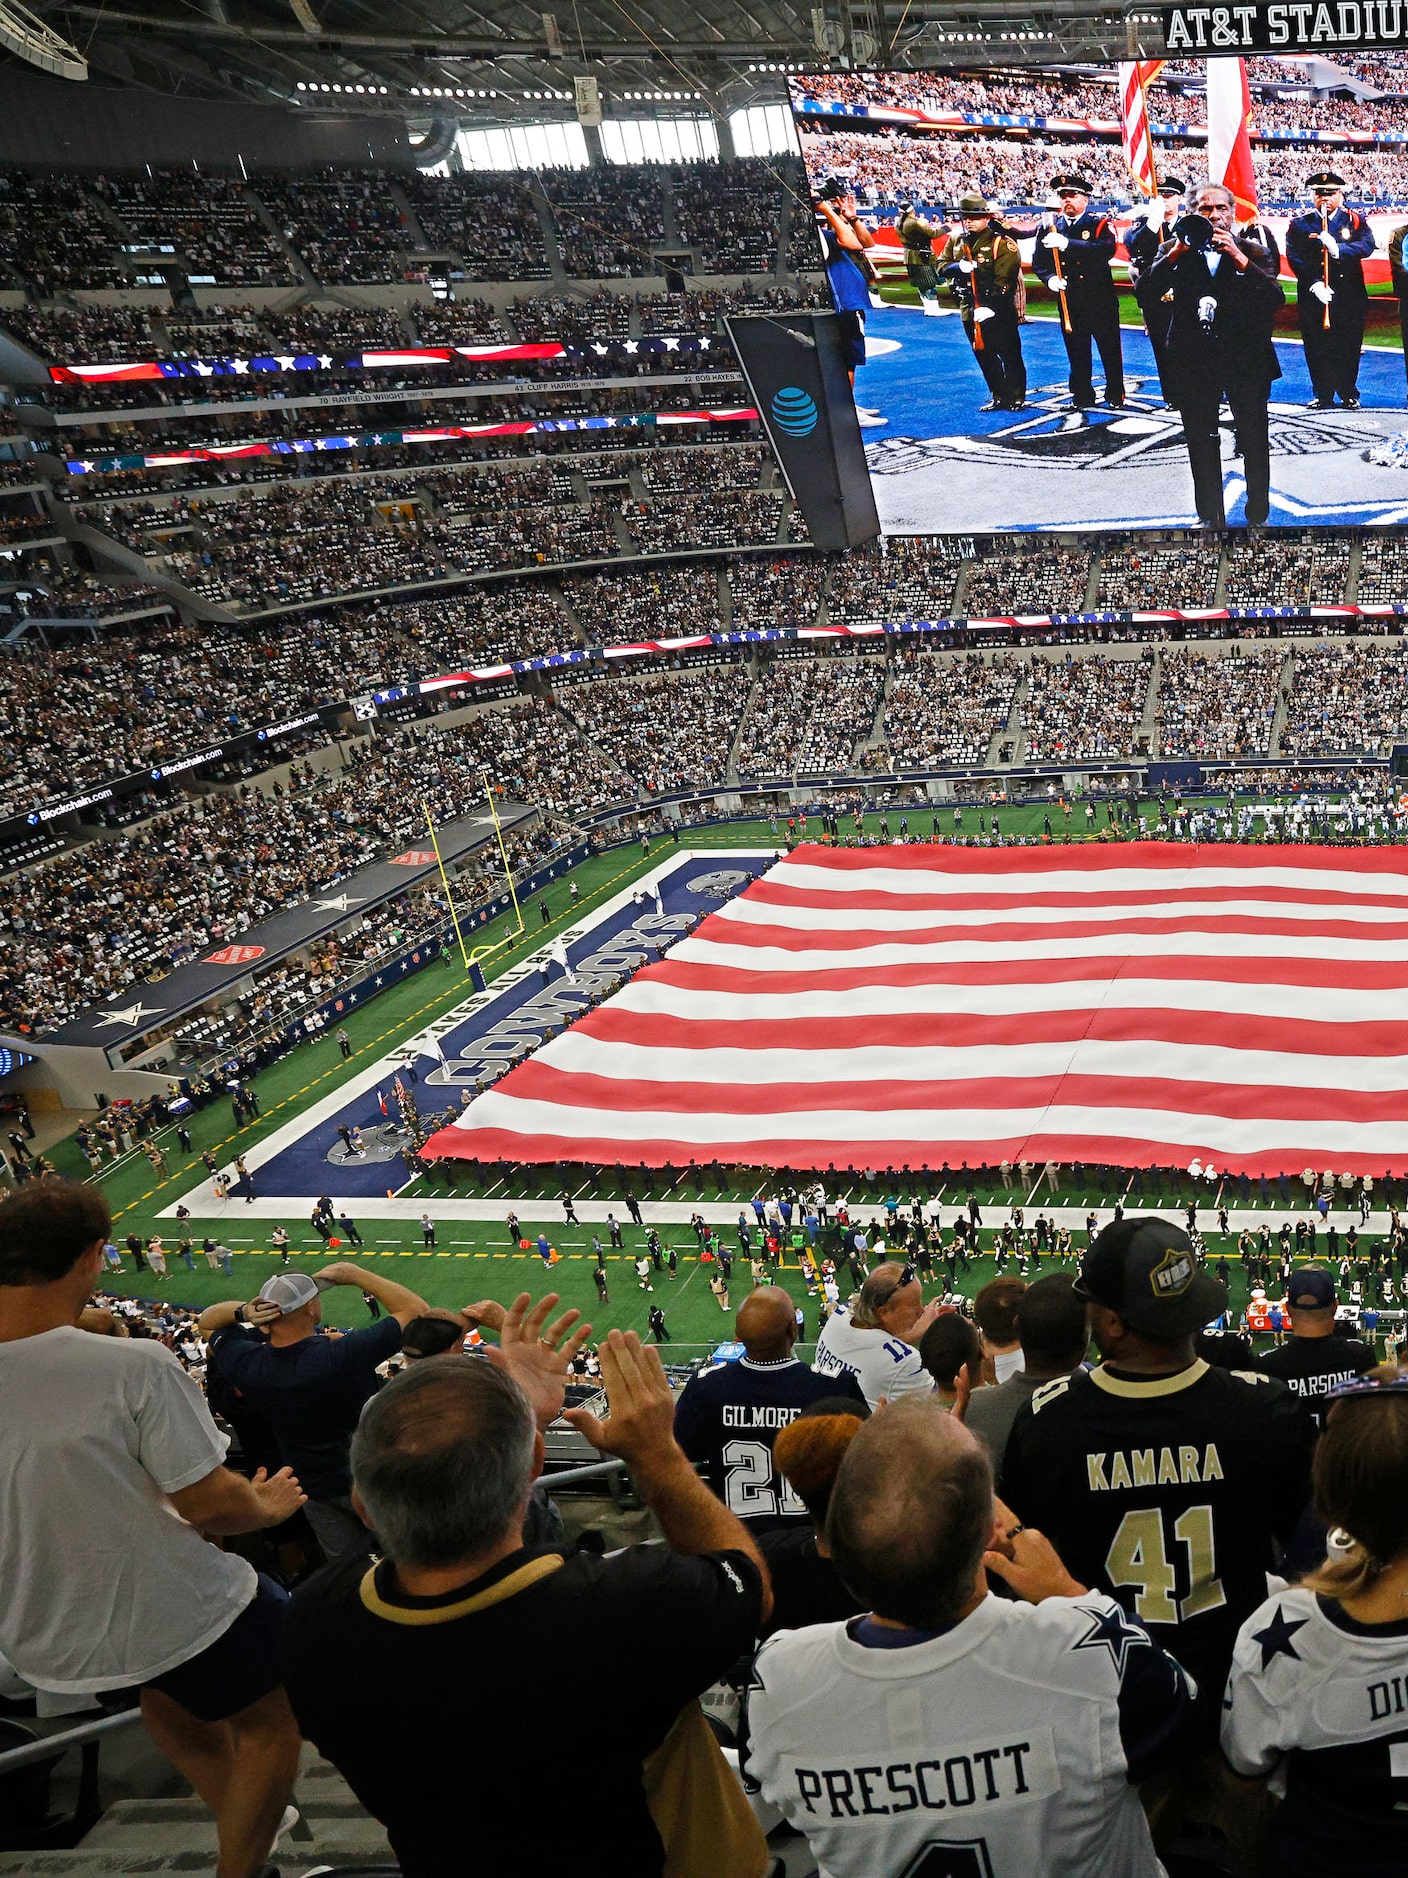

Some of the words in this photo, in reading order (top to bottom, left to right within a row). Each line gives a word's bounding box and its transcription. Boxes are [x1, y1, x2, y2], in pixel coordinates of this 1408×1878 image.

[1166, 6, 1257, 49] AT&T
[527, 383, 549, 391] CLIFF
[550, 382, 579, 390] HARRIS
[683, 375, 693, 383] 22
[695, 374, 711, 382] BOB
[712, 373, 736, 381] HAYES
[319, 397, 329, 405] 70
[332, 395, 372, 404] RAYFIELD
[373, 392, 405, 401] WRIGHT
[265, 712, 319, 738] Blockchain.com
[161, 748, 223, 776] Blockchain.com
[38, 787, 113, 821] Blockchain.com
[424, 912, 698, 1087] COWBOYS
[1254, 1317, 1265, 1328] G
[883, 1338, 913, 1364] 11
[722, 1405, 802, 1429] GILMORE
[1086, 1443, 1225, 1491] KAMARA
[720, 1560, 744, 1593] Reebok
[1104, 1504, 1228, 1625] 41
[794, 1741, 1031, 1818] PRESCOTT
